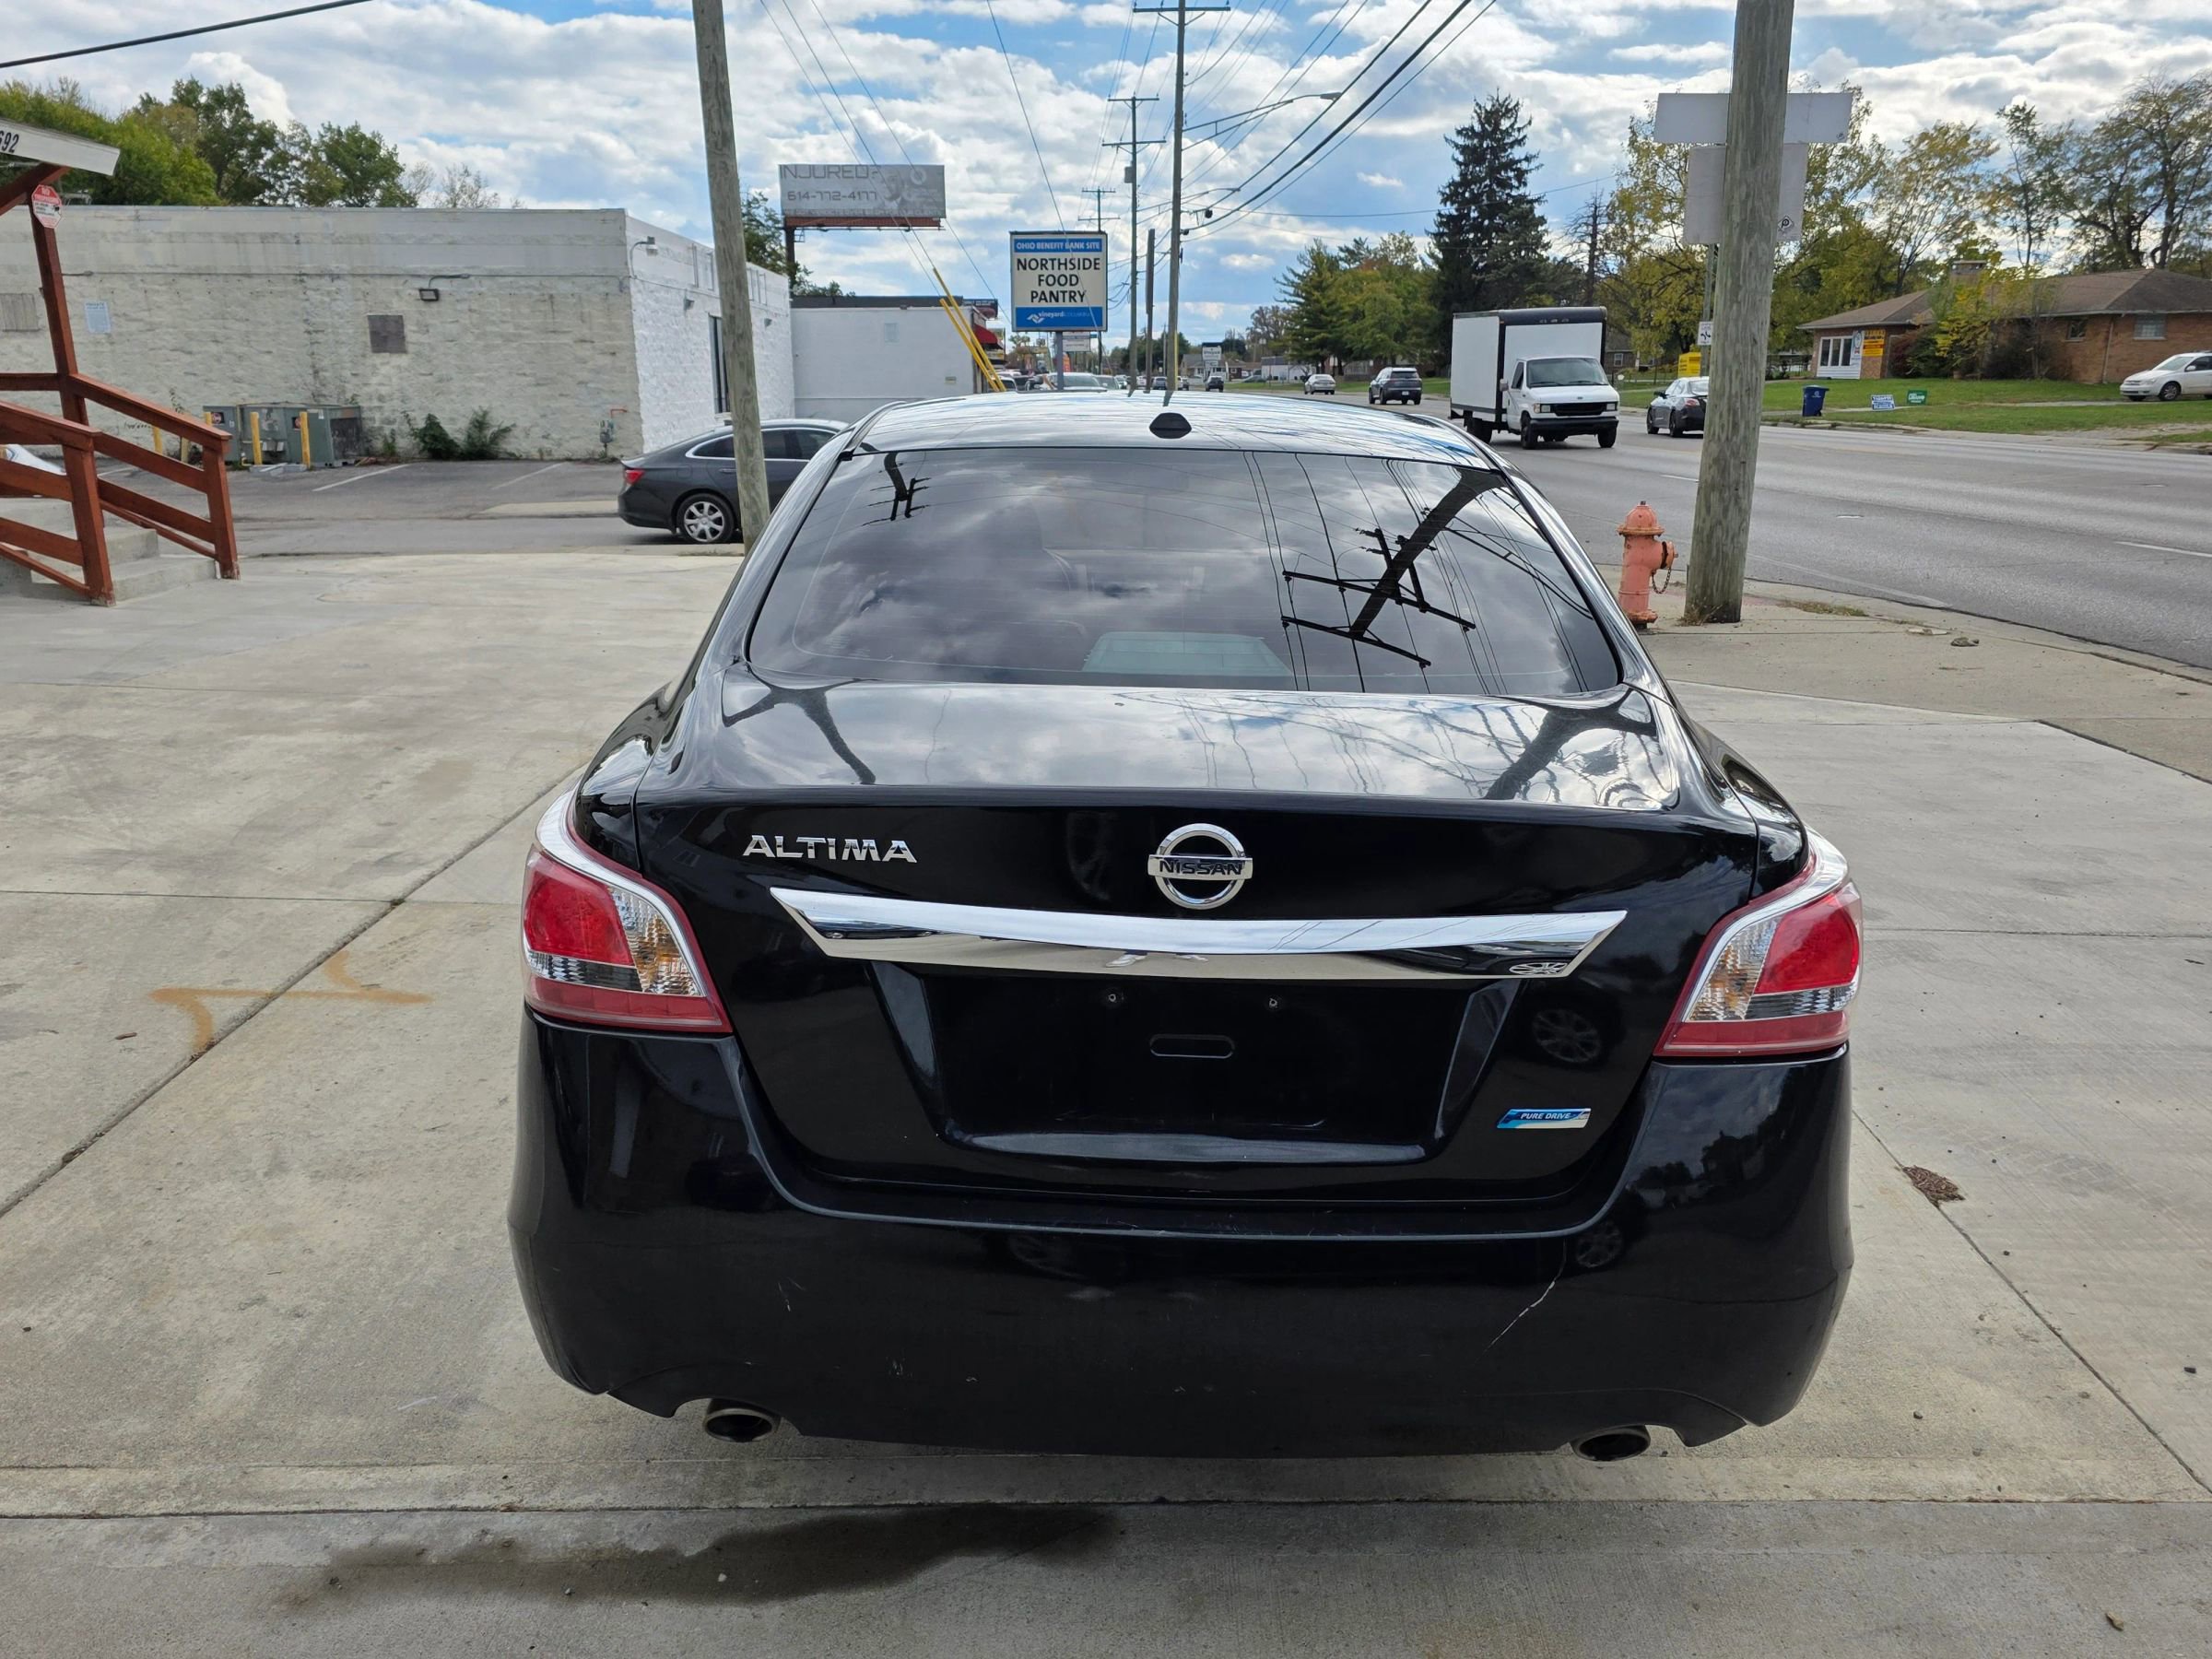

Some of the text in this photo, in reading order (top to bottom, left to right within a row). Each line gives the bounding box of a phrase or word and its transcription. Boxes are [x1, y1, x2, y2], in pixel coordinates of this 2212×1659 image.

[787, 191, 877, 201] 614-772-4177
[1017, 258, 1100, 271] NORTHSIDE
[1038, 274, 1079, 287] FOOD
[1030, 290, 1087, 303] PANTRY
[743, 835, 917, 863] ALTIMA
[1159, 860, 1242, 876] NISSAN
